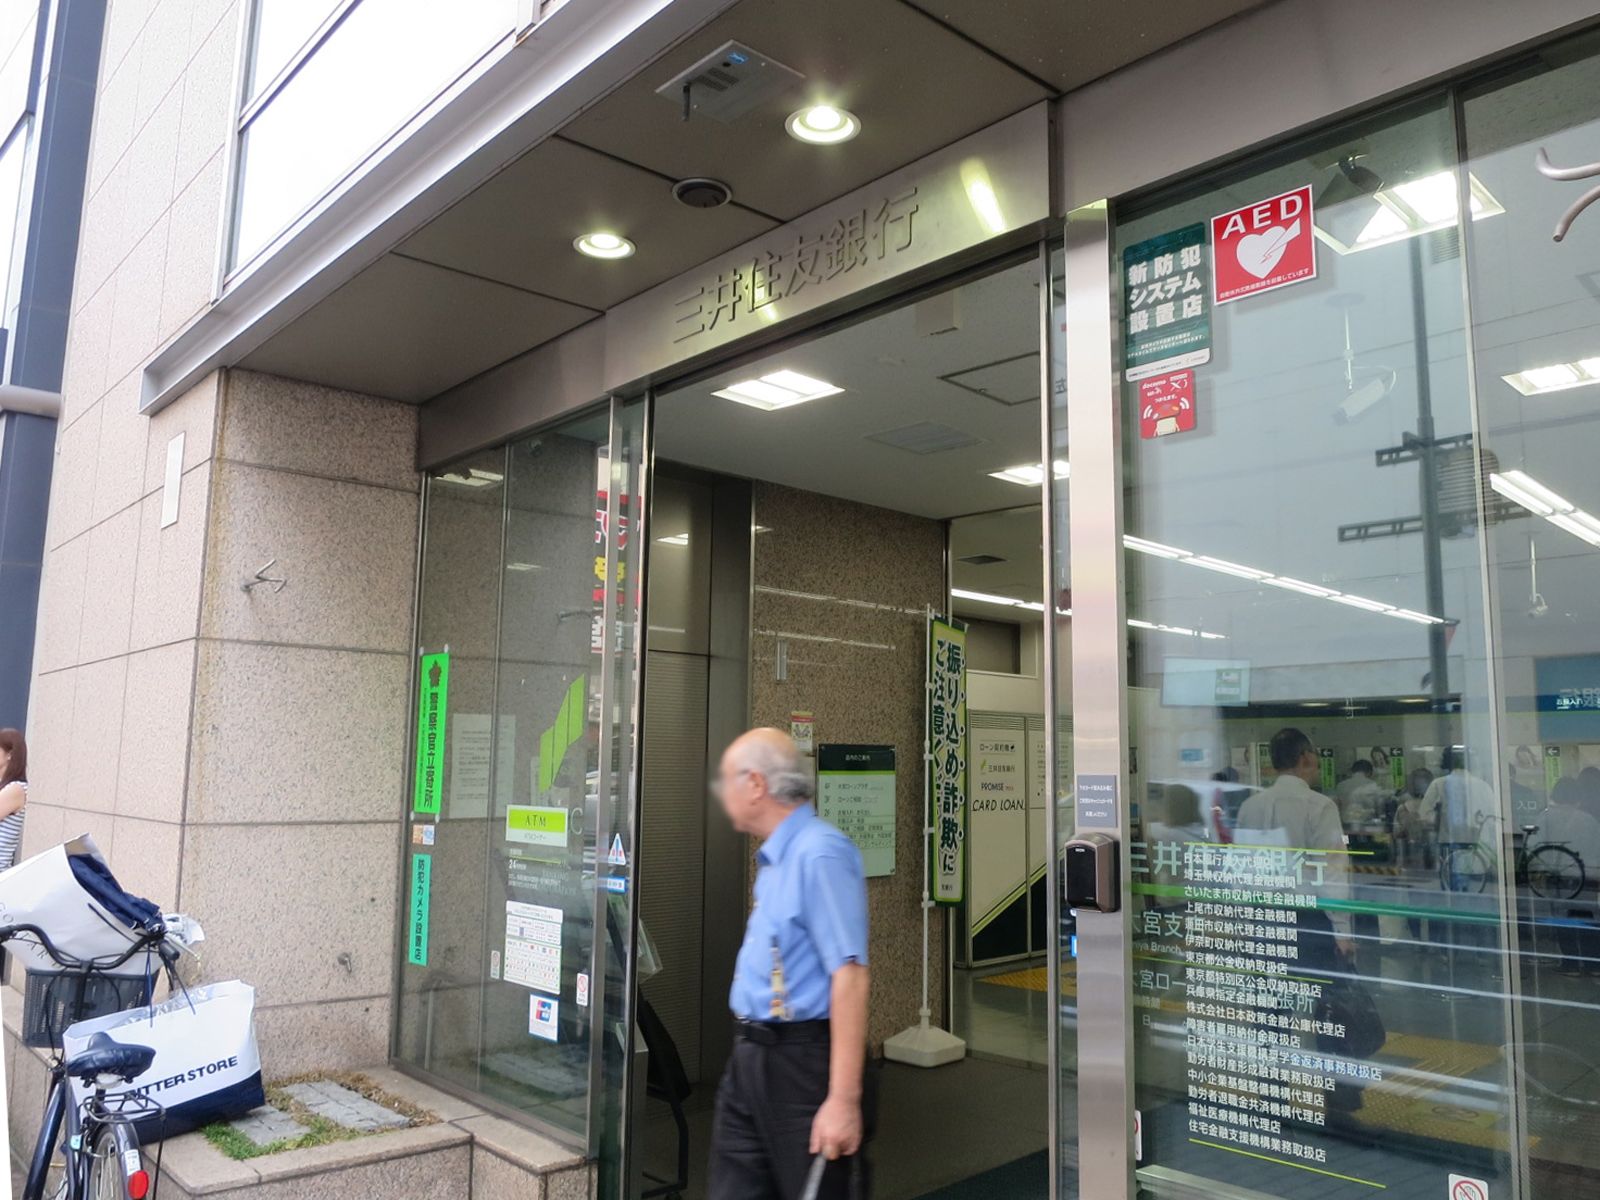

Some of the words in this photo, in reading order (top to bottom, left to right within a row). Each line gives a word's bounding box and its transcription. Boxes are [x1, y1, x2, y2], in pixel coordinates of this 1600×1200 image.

[1221, 195, 1303, 241] AED
[673, 186, 919, 345] 三井住友銀行
[1129, 243, 1201, 287] 新防犯
[1129, 271, 1202, 311] システム
[1129, 294, 1203, 334] 設置店
[941, 642, 961, 872] 振り込め詐欺に
[526, 814, 546, 828] ATM
[972, 799, 998, 812] CARD
[1000, 799, 1025, 811] LOAN
[1184, 885, 1317, 908] さいたま市収納代理金融機関
[1185, 901, 1297, 924] 上尾市収納代理金融機関
[1151, 941, 1182, 954] Branch
[1185, 934, 1298, 959] 伊奈町収納代理金融機関
[1186, 1001, 1346, 1038] 株式会社日本政策金融公庫代理店
[187, 1055, 238, 1081] STORE
[1188, 1068, 1325, 1107] 中小企業基盤整備機構代理店
[1188, 1084, 1326, 1126] 勤労者退職金共済機構代理店
[1188, 1101, 1281, 1134] 福祉医療機構代理店
[1188, 1118, 1327, 1162] 住宅金融支援機構業務取扱店
